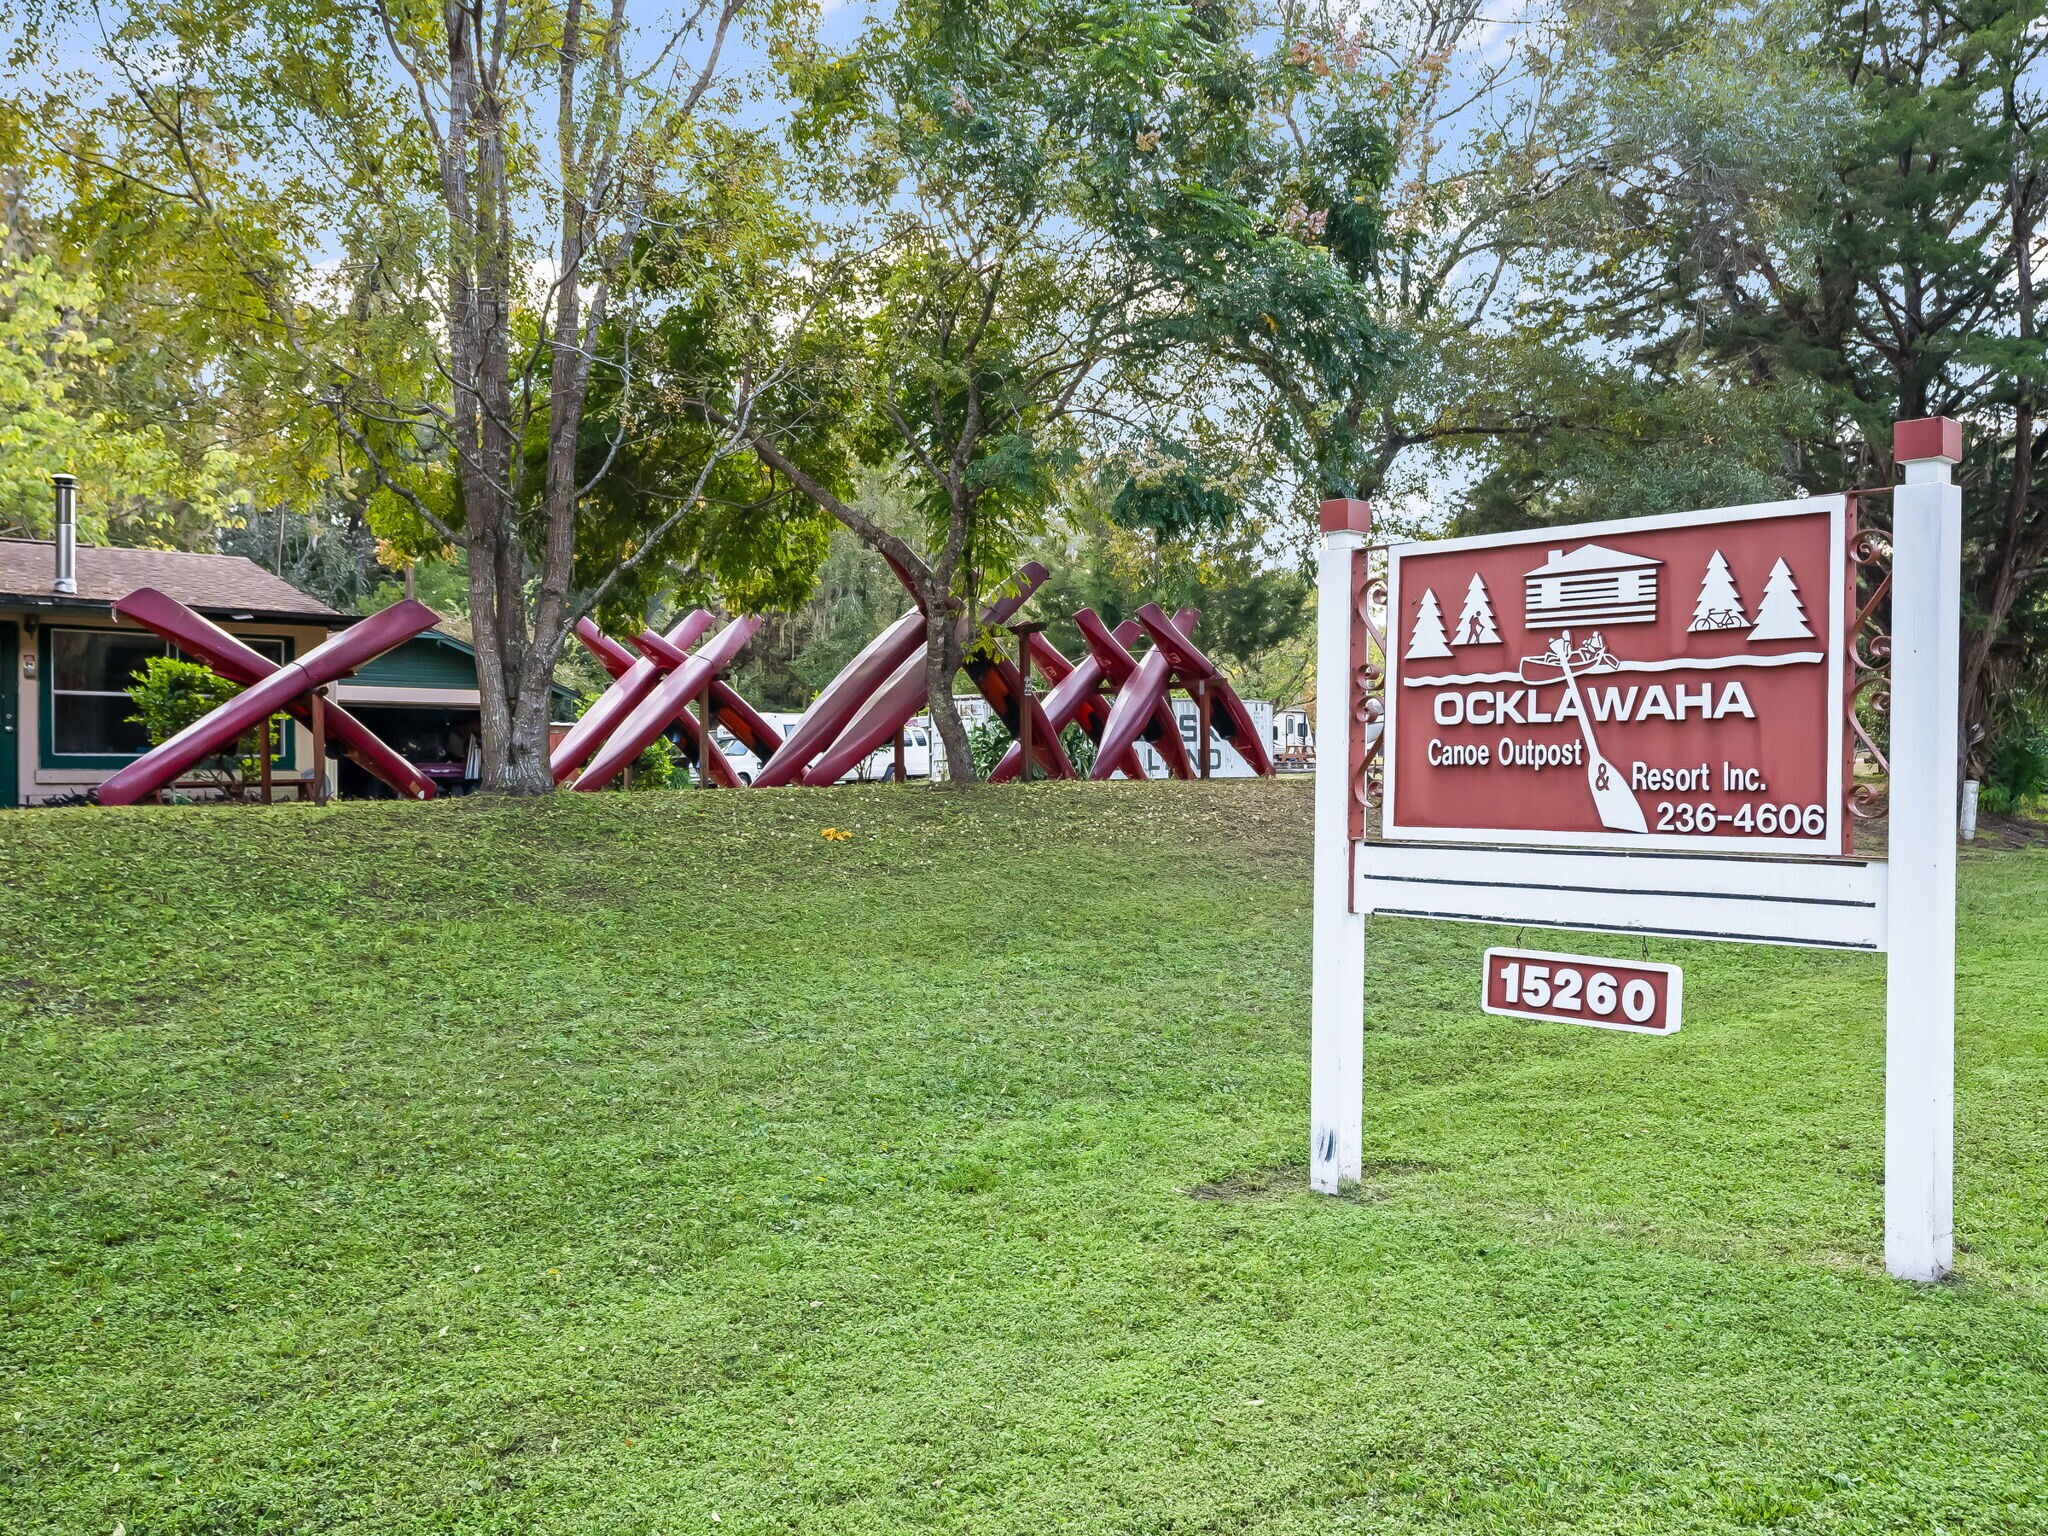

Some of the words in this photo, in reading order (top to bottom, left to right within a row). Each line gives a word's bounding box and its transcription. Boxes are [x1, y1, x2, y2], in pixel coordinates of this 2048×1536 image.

[1433, 681, 1756, 726] OCKLAWAHA
[1427, 738, 1491, 767] Canoe
[1498, 737, 1583, 771] Outpost
[1595, 763, 1610, 792] &
[1632, 761, 1710, 793] Resort
[1722, 761, 1767, 792] Inc.
[1655, 801, 1826, 836] 236-4606
[1500, 962, 1657, 1023] 15260
